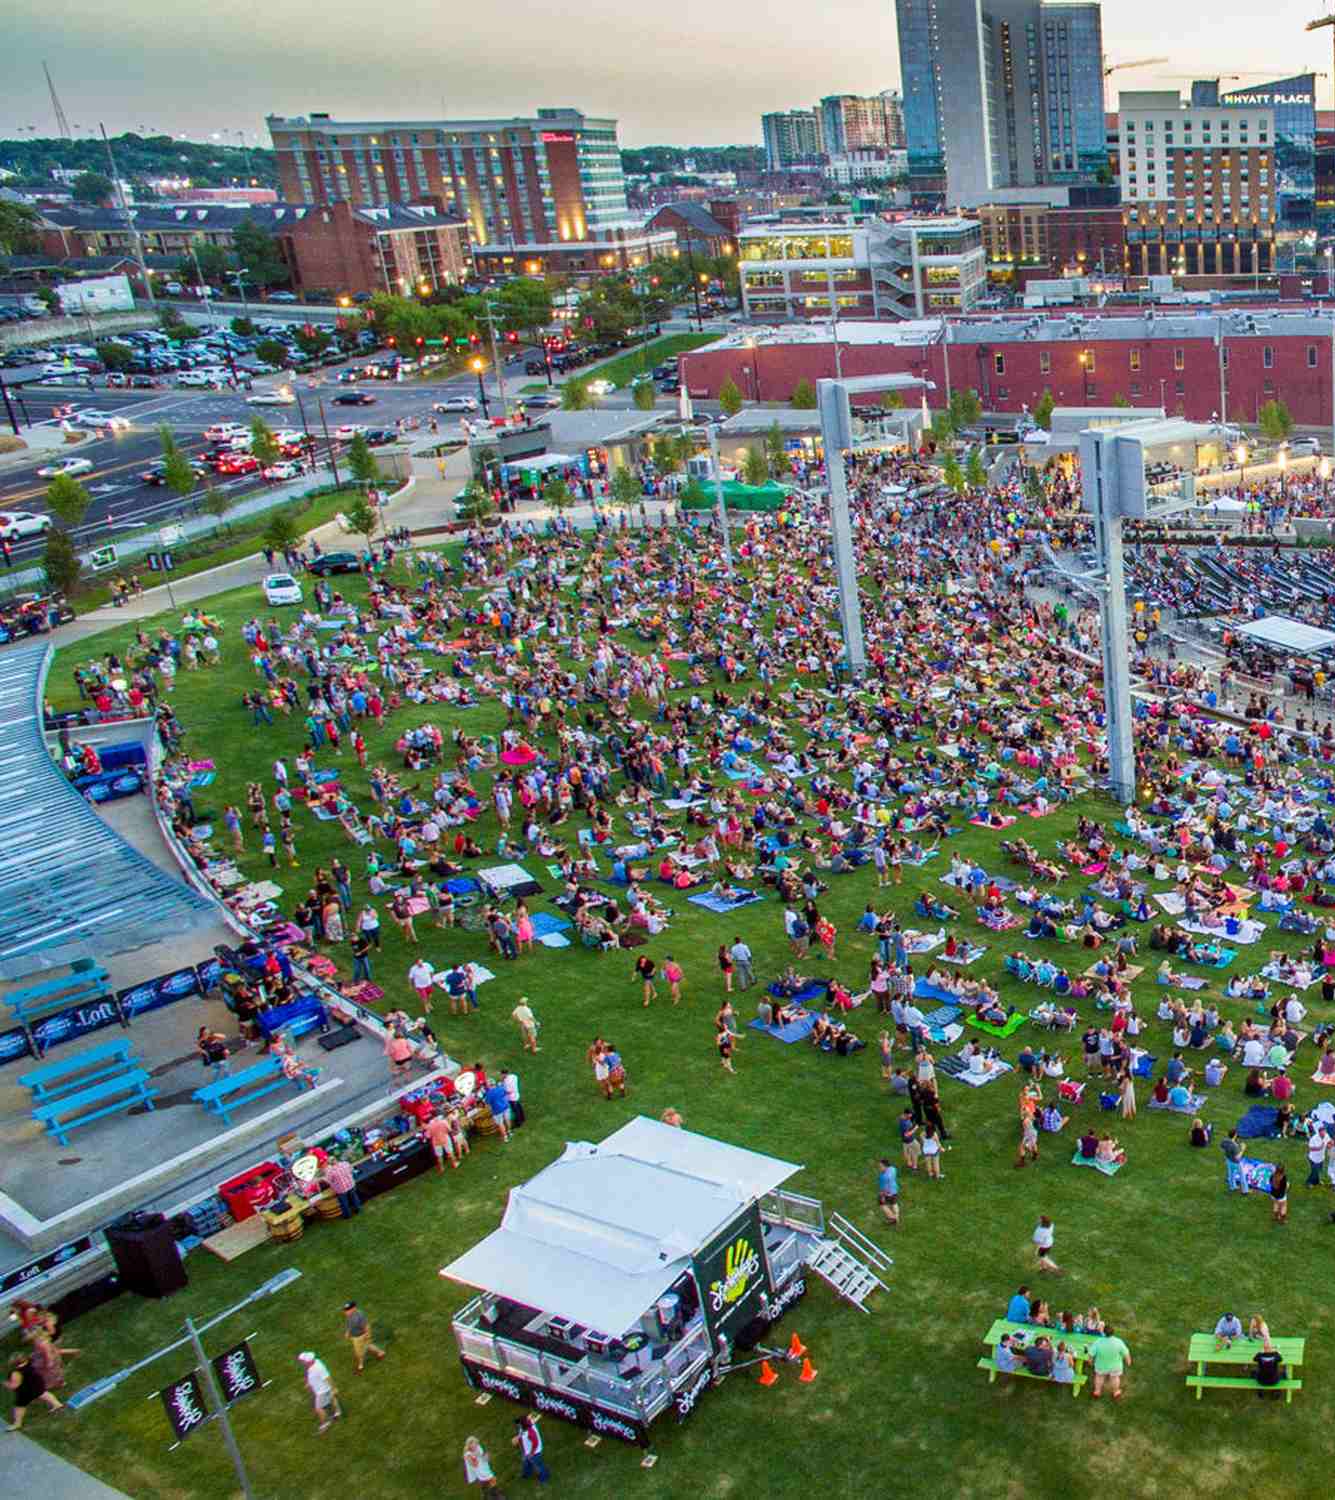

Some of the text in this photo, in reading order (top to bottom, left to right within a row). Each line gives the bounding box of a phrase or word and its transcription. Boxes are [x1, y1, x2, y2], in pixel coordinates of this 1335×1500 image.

[1234, 94, 1311, 105] HYATT PLACE
[77, 1001, 114, 1027] Loft
